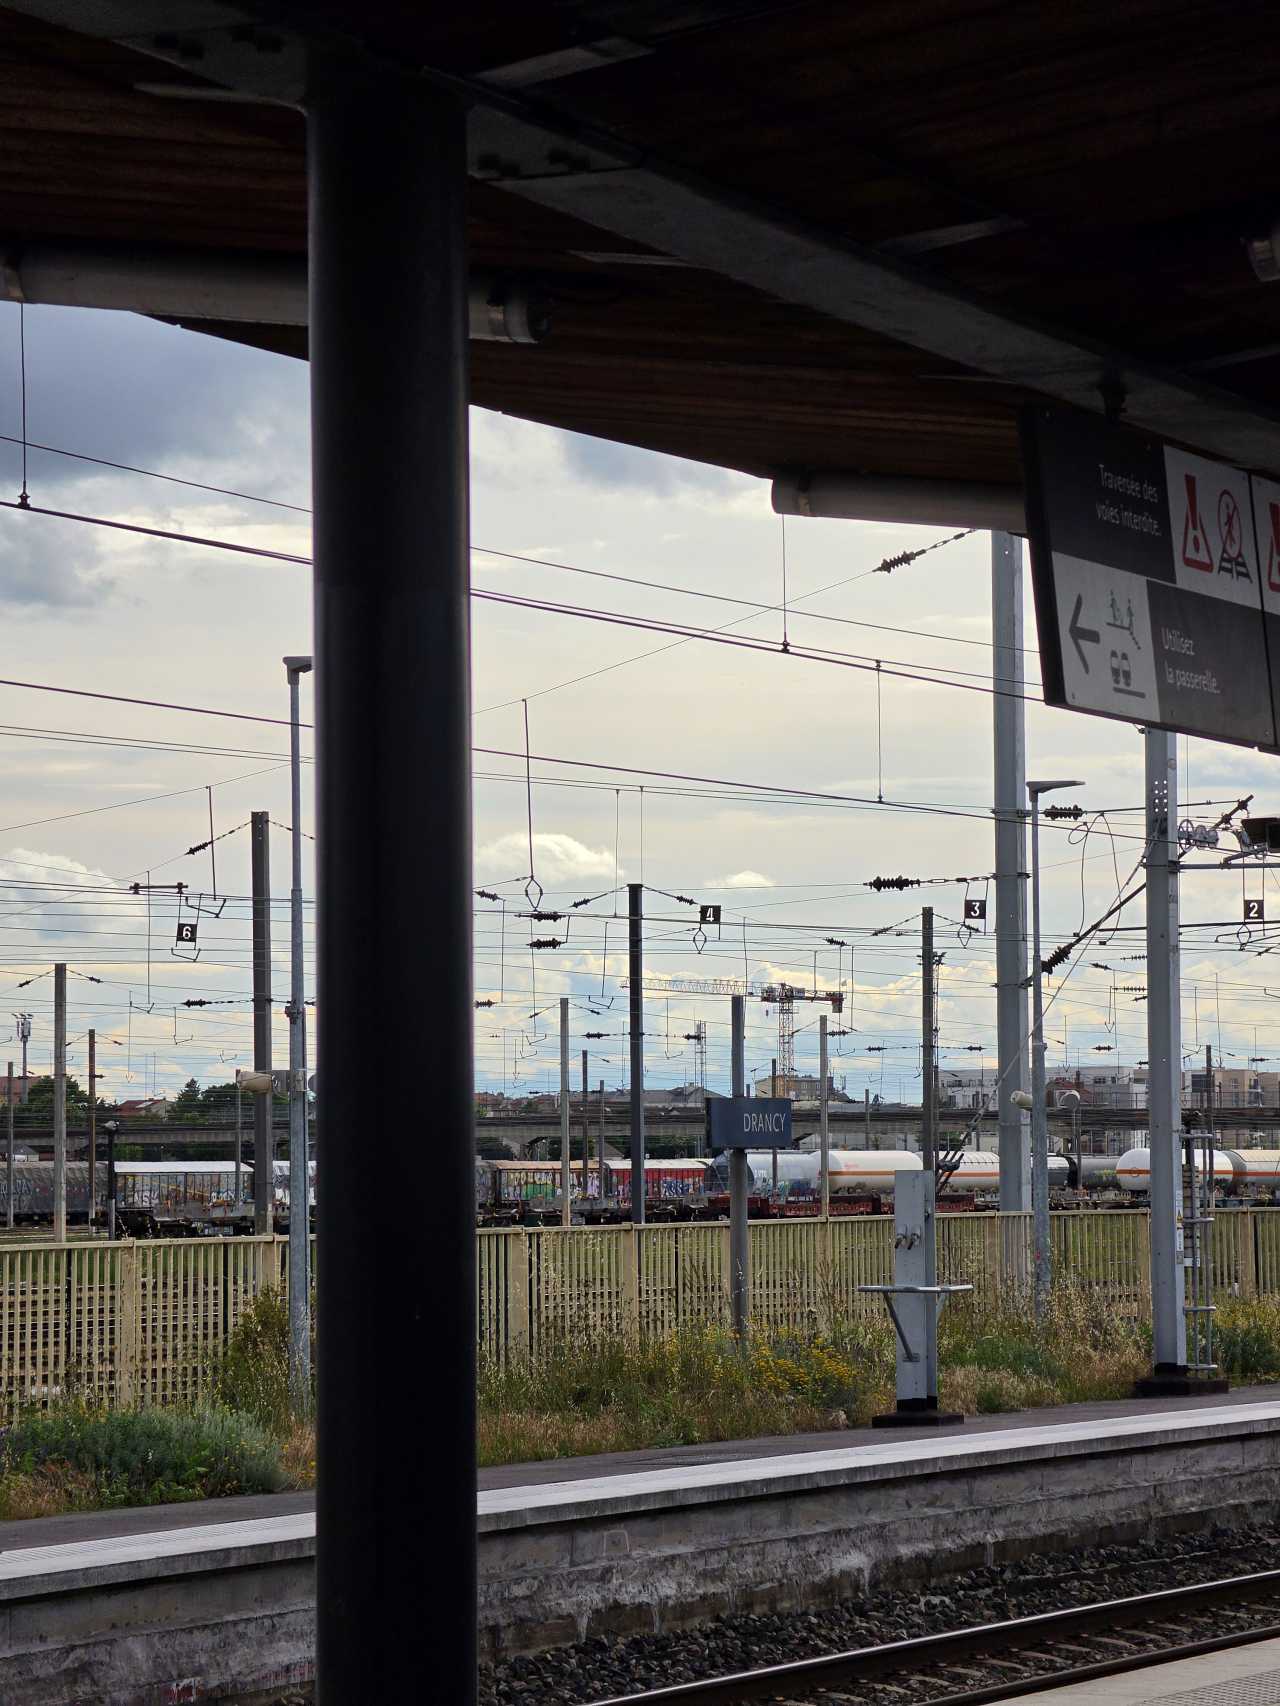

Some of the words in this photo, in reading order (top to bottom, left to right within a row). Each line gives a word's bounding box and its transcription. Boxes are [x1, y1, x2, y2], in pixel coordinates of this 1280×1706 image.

[1099, 464, 1141, 498] Traversée
[1142, 480, 1158, 503] des
[1096, 501, 1120, 524] voies
[1161, 627, 1195, 655] Utilisez
[1165, 660, 1175, 684] la
[706, 907, 715, 922] 4
[970, 902, 980, 916] 3
[1249, 903, 1258, 917] 2
[182, 926, 192, 939] 6
[743, 1113, 786, 1132] DRANCY
